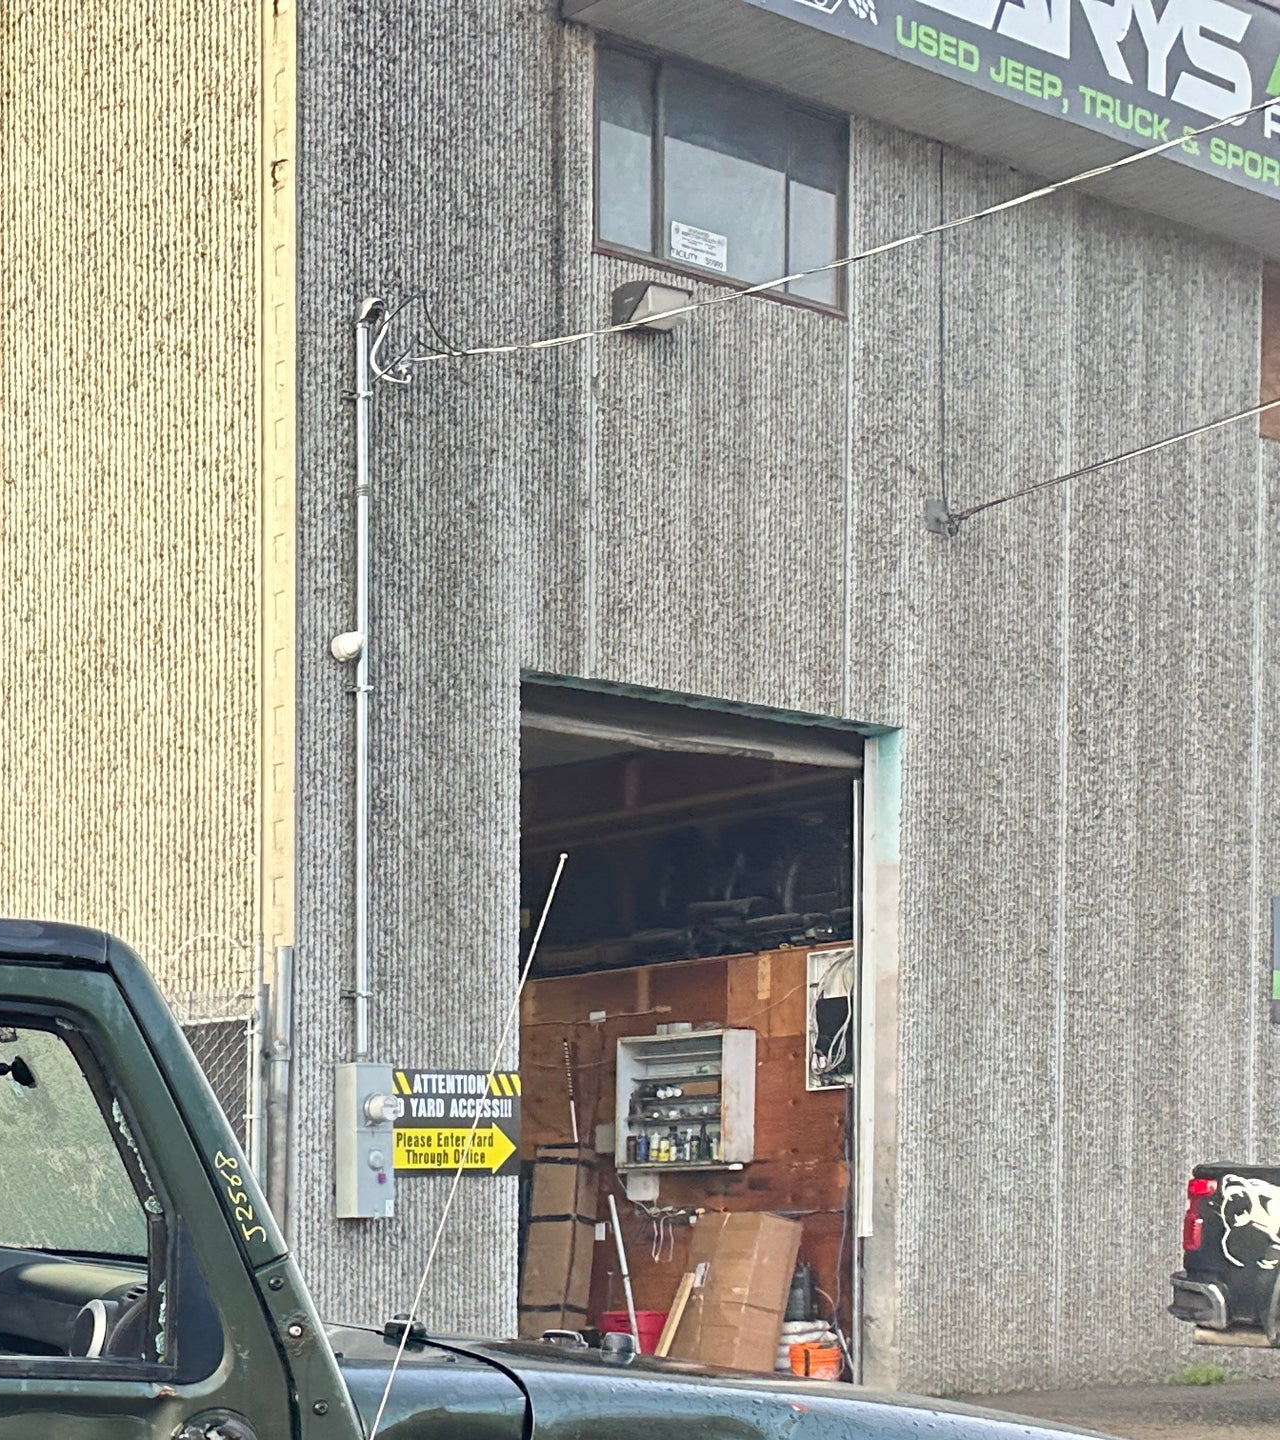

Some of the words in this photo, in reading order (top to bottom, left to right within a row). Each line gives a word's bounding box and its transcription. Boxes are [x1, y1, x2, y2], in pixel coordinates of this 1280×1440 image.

[895, 15, 980, 73] USED
[989, 56, 1069, 115] JEEP,
[1078, 85, 1171, 143] TRUCK
[412, 1073, 487, 1095] ATTENTION
[409, 1097, 445, 1118] YARD
[396, 1131, 432, 1148] Please
[436, 1132, 466, 1148] Enter
[405, 1149, 449, 1167] Through
[214, 1150, 267, 1243] J2568
